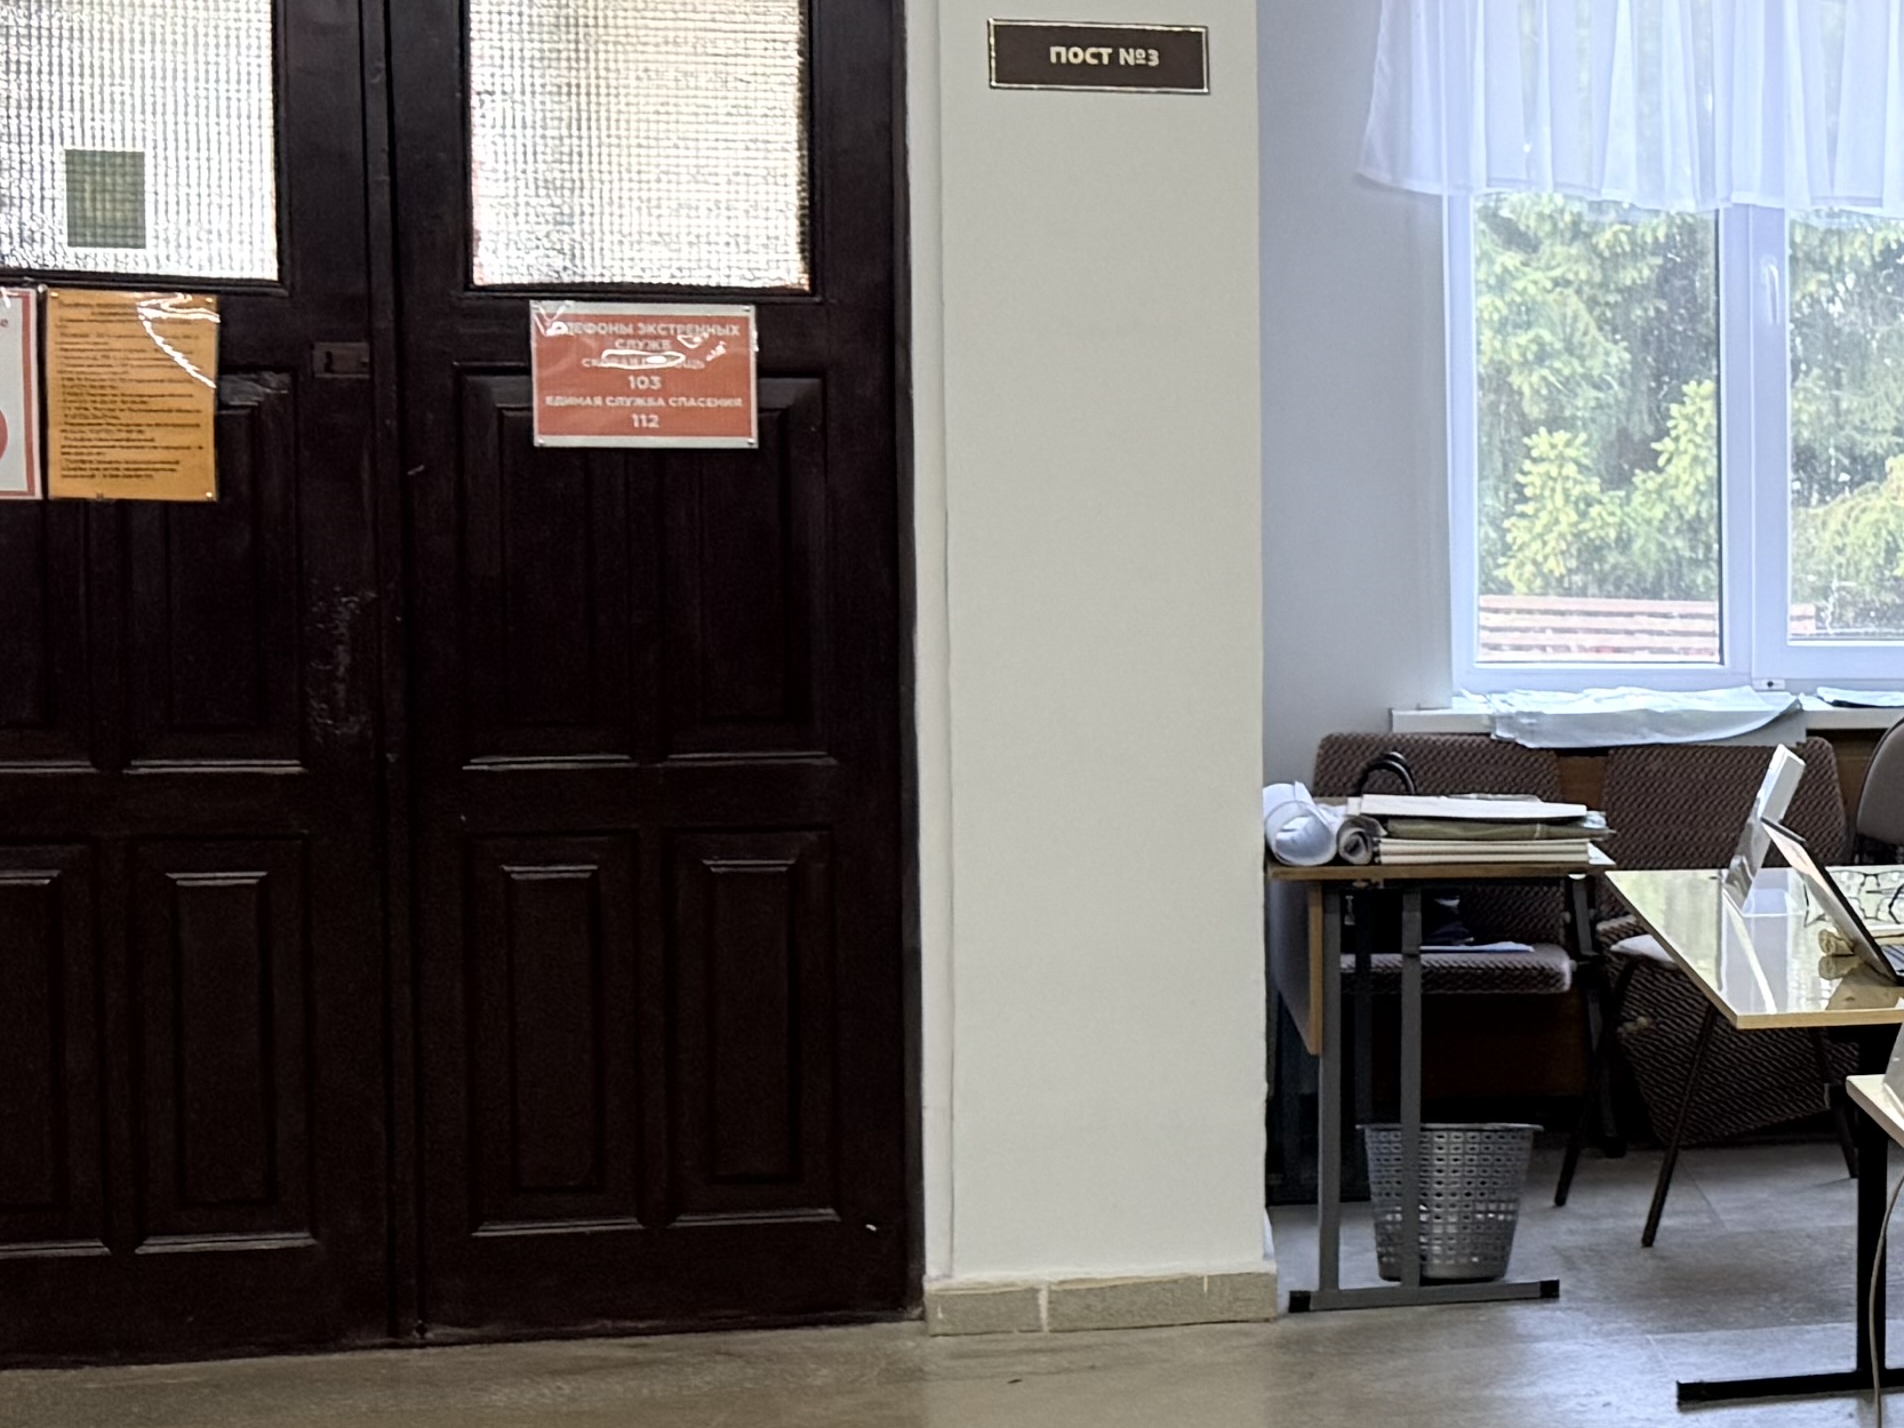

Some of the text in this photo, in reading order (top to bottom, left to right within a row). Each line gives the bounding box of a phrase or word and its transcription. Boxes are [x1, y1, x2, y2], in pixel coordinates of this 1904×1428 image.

[1050, 46, 1159, 66] ПОСТ №3
[638, 323, 740, 336] ЭКСТРЕННЫХ
[615, 339, 672, 350] СЛУЖБ
[628, 375, 662, 390] 103
[545, 396, 743, 408] ЕДИНАЯ СЛУЖБА СПАСЕНИЯ
[631, 414, 660, 428] 112
